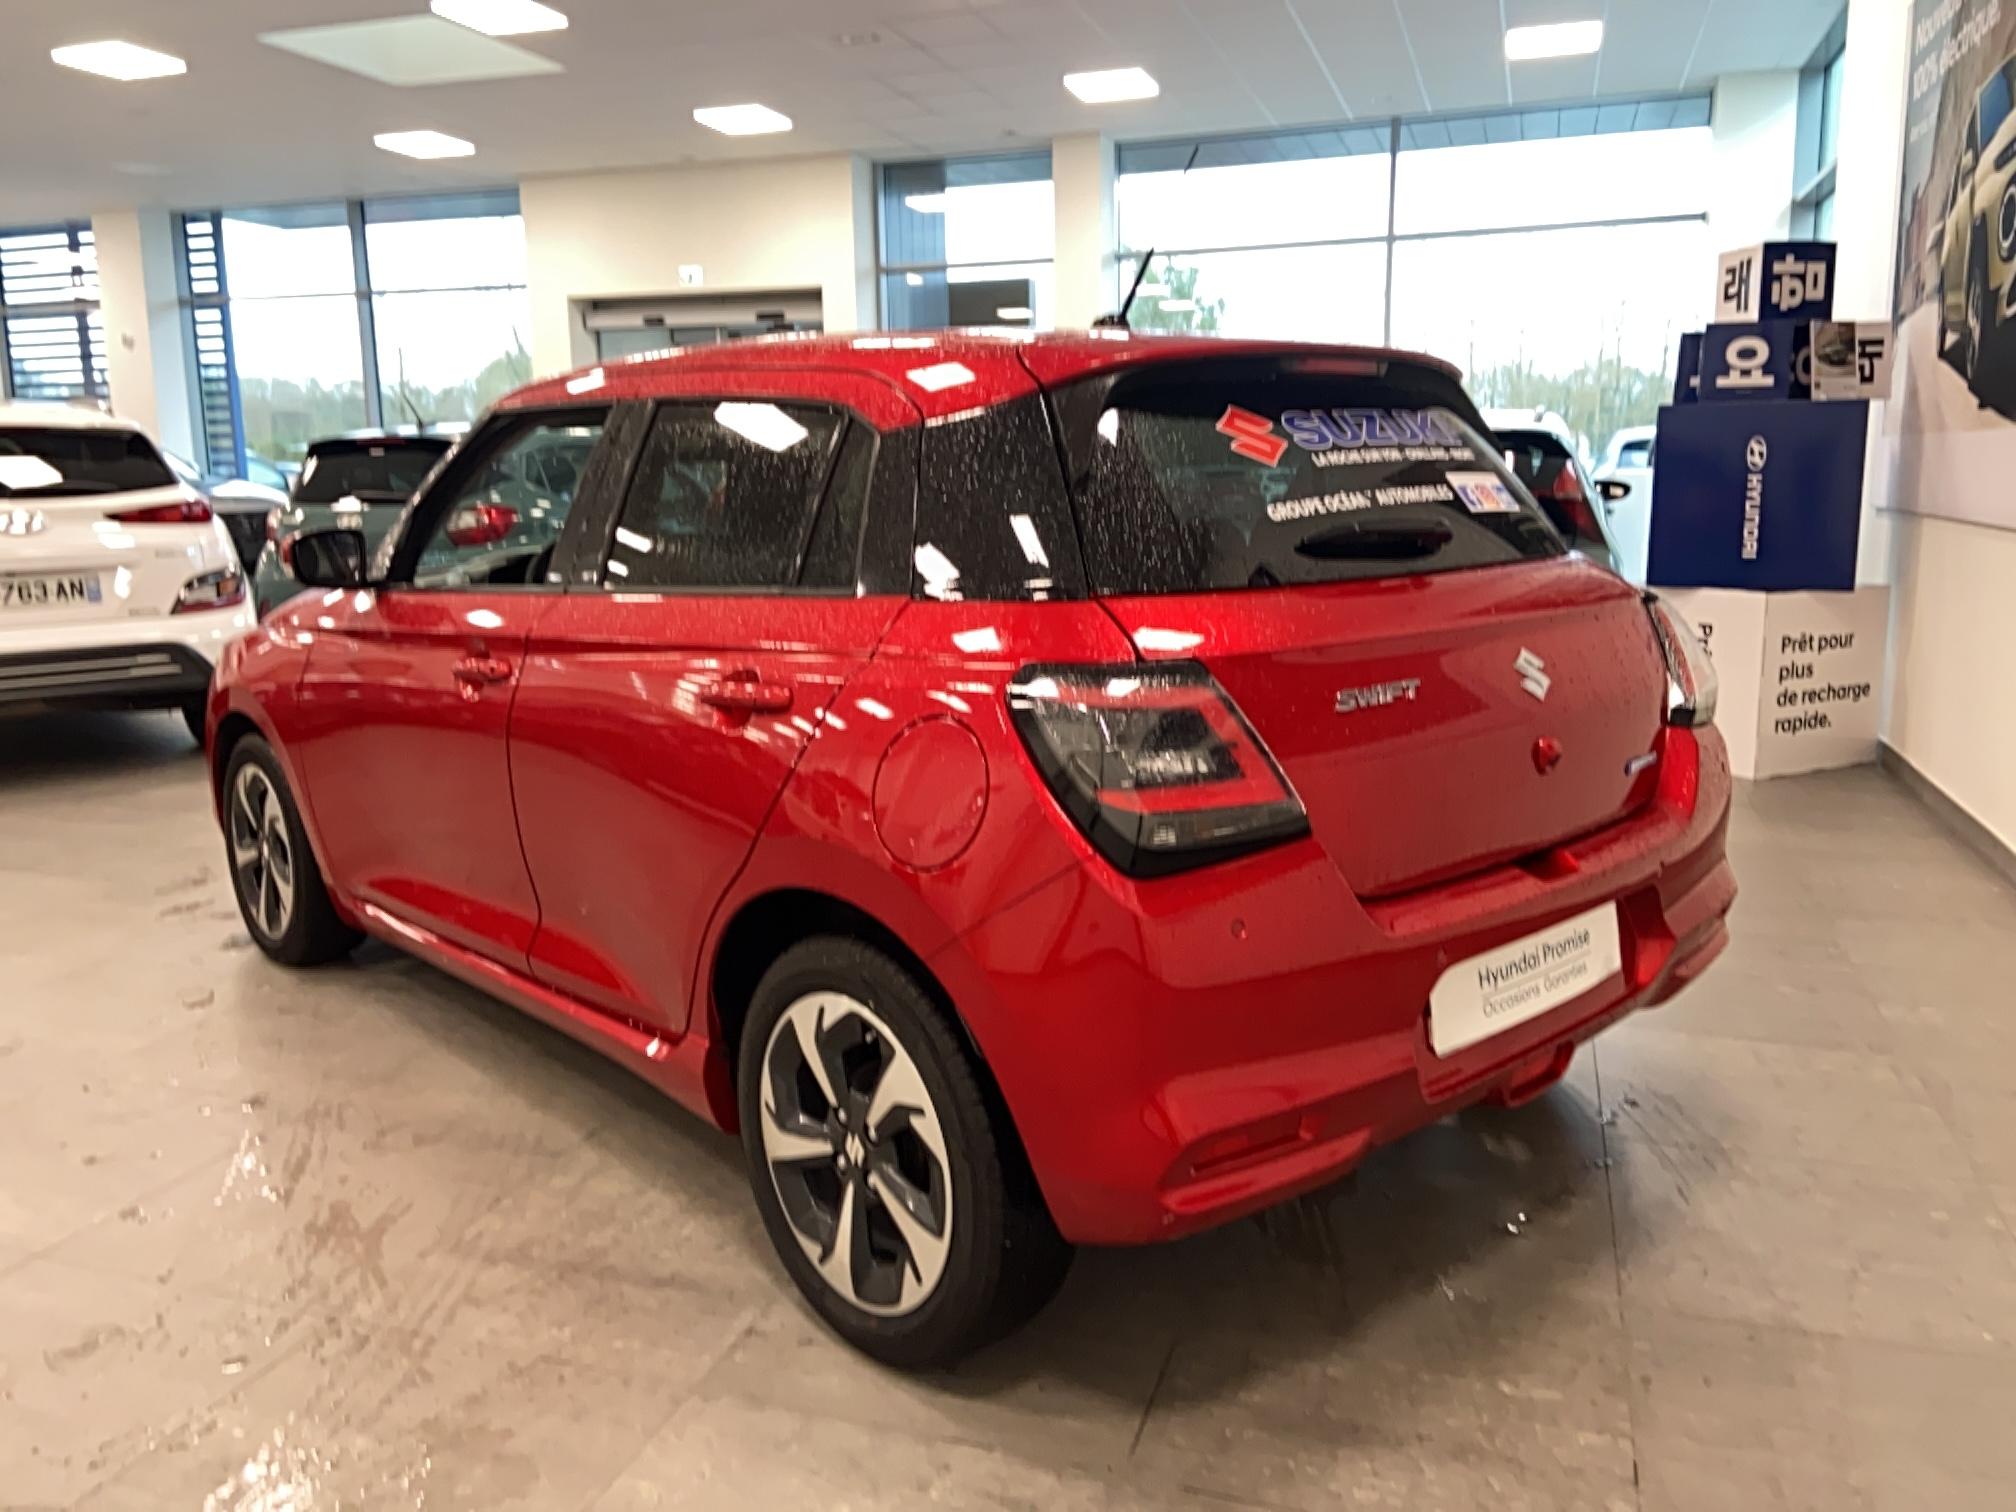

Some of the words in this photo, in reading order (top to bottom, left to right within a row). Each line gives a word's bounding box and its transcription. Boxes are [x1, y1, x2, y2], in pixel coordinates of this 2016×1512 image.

[1741, 473, 1763, 560] HYUNDAI
[56, 577, 86, 605] AN
[1781, 631, 1814, 654] Prêt
[1818, 632, 1854, 655] pour
[1779, 660, 1813, 685] plus
[1334, 678, 1421, 713] SWIFT
[1776, 687, 1798, 707] de
[1801, 682, 1870, 705] recharge
[1774, 710, 1832, 735] rapide.
[1478, 946, 1541, 991] Hyundai
[1542, 928, 1591, 962] Promise
[1482, 983, 1541, 1018] Occasions
